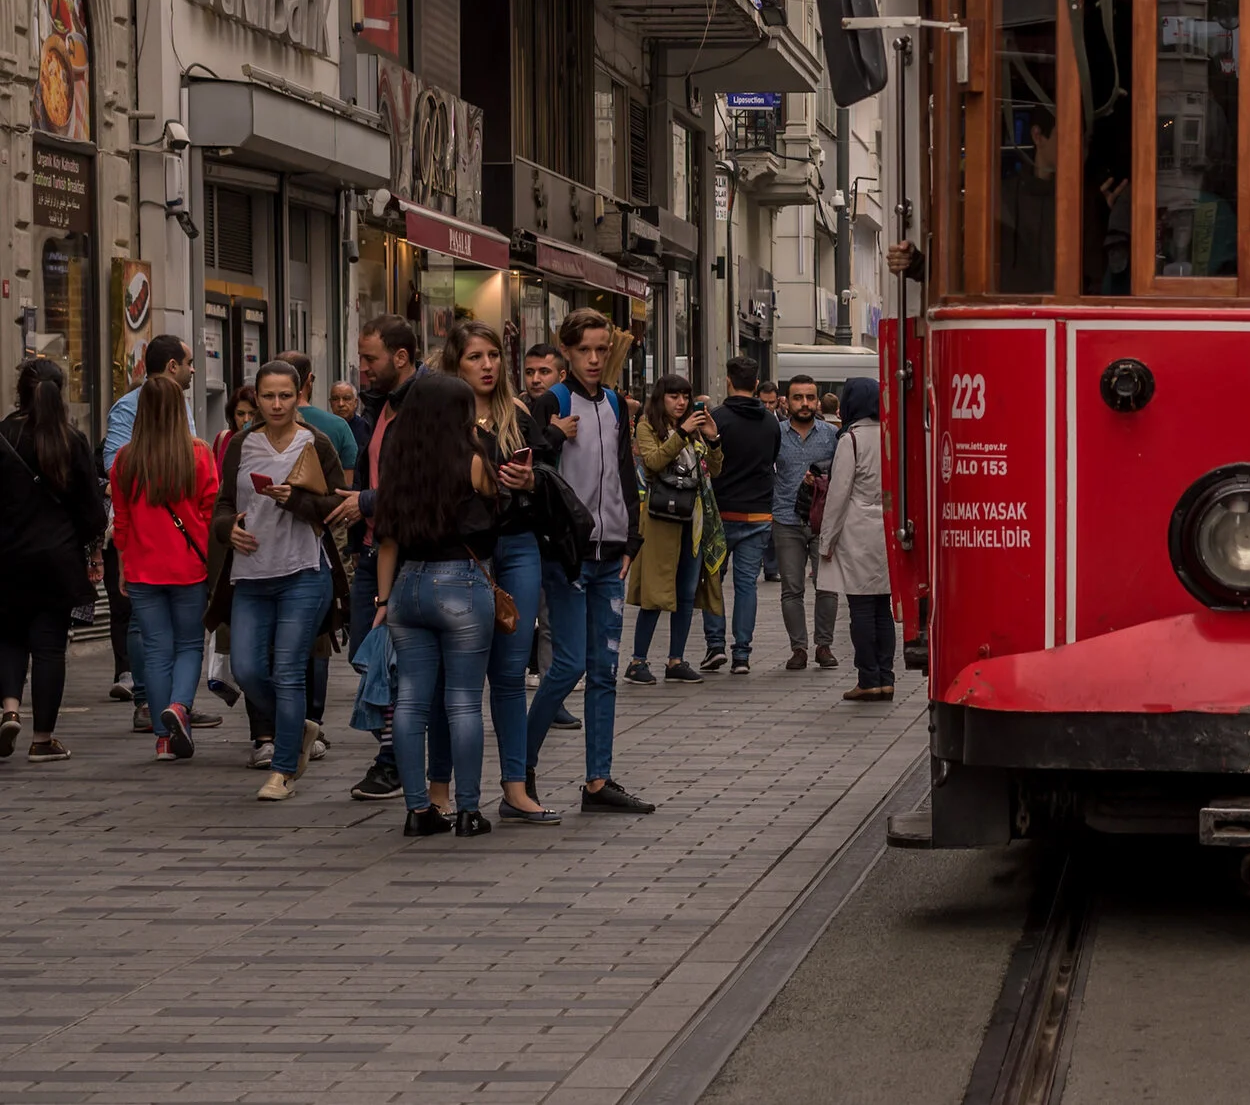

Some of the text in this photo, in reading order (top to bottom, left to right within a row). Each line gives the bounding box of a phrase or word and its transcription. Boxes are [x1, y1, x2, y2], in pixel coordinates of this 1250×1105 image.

[733, 96, 765, 105] Liposuction
[952, 373, 985, 419] 223
[956, 442, 1007, 452] www.iett.gov.tr
[956, 460, 1007, 476] ALO 153
[942, 502, 1027, 520] ASILMAK YASAK
[950, 526, 1031, 548] TEHLİKELİDİR
